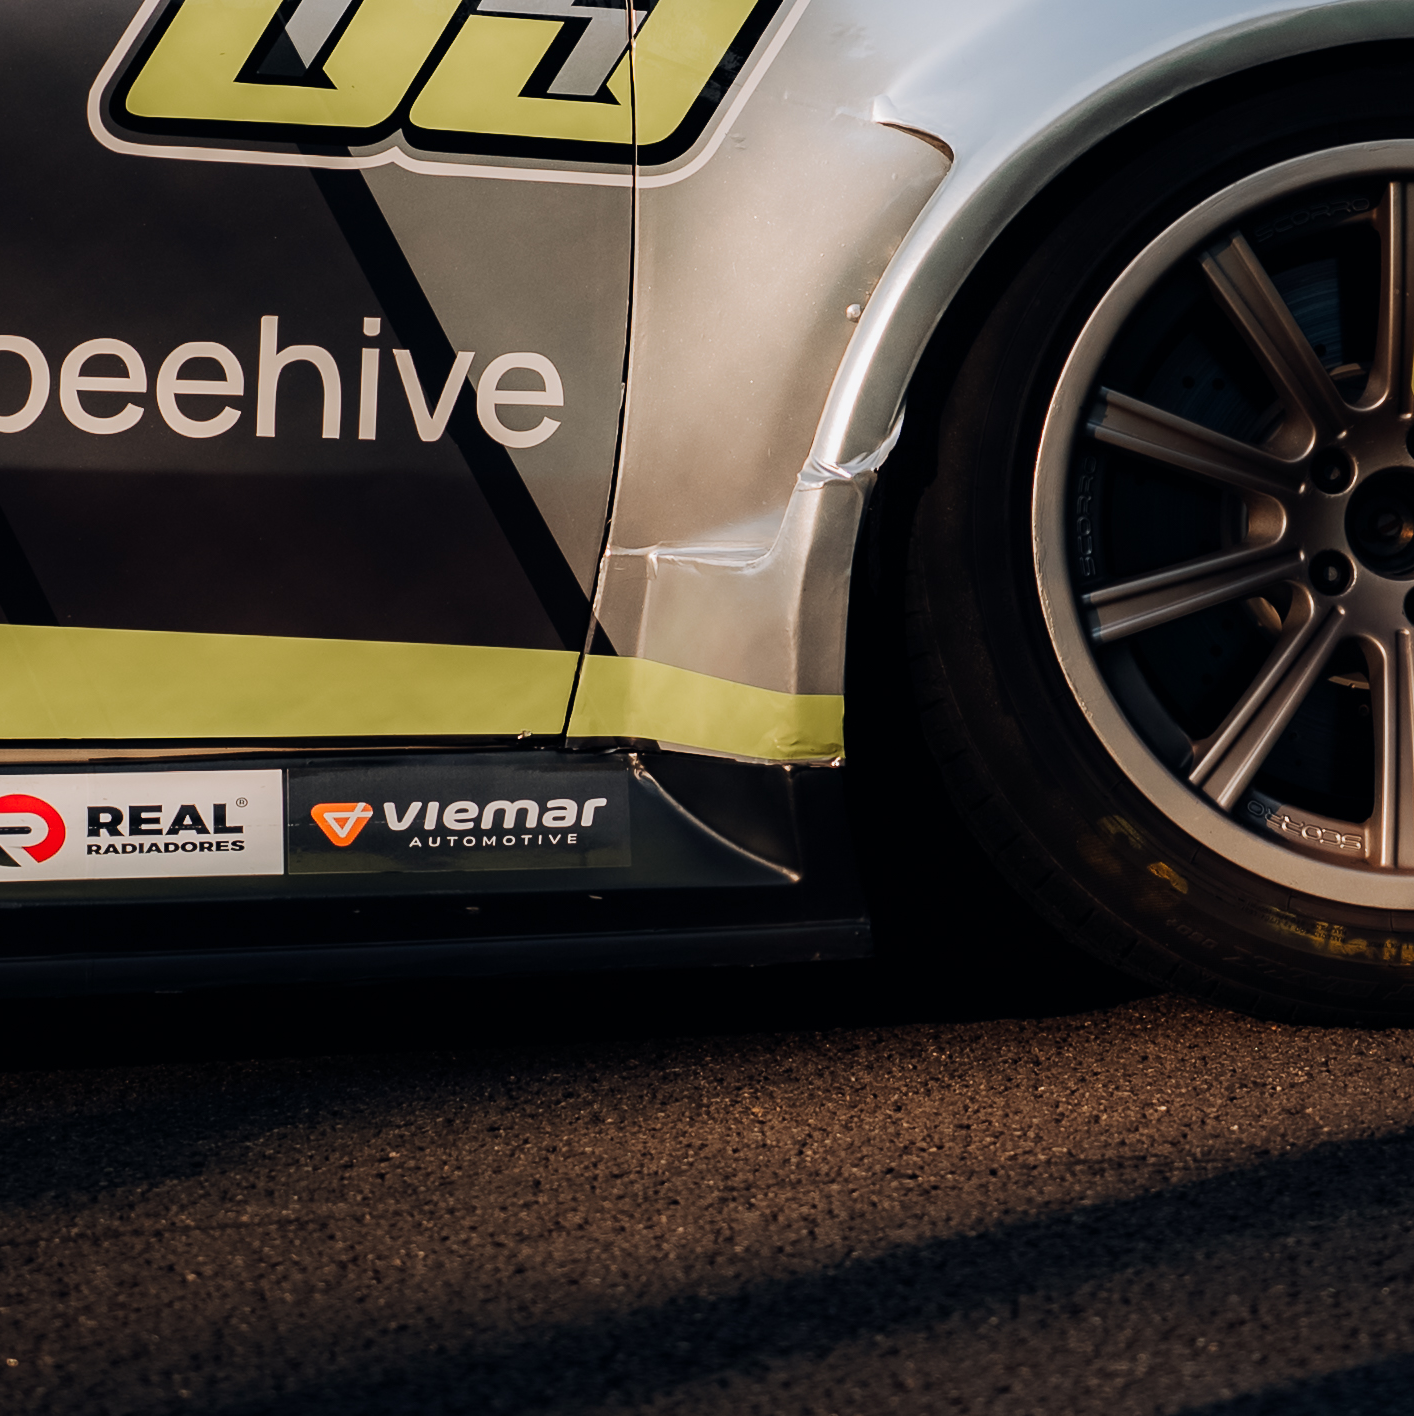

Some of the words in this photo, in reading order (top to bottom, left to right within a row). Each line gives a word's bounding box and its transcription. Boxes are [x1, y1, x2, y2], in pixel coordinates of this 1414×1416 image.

[1253, 196, 1371, 244] SCORRO
[408, 833, 579, 849] AUTOMOTIVE
[1246, 799, 1364, 852] SCORRO
[86, 839, 246, 856] RADIADORES
